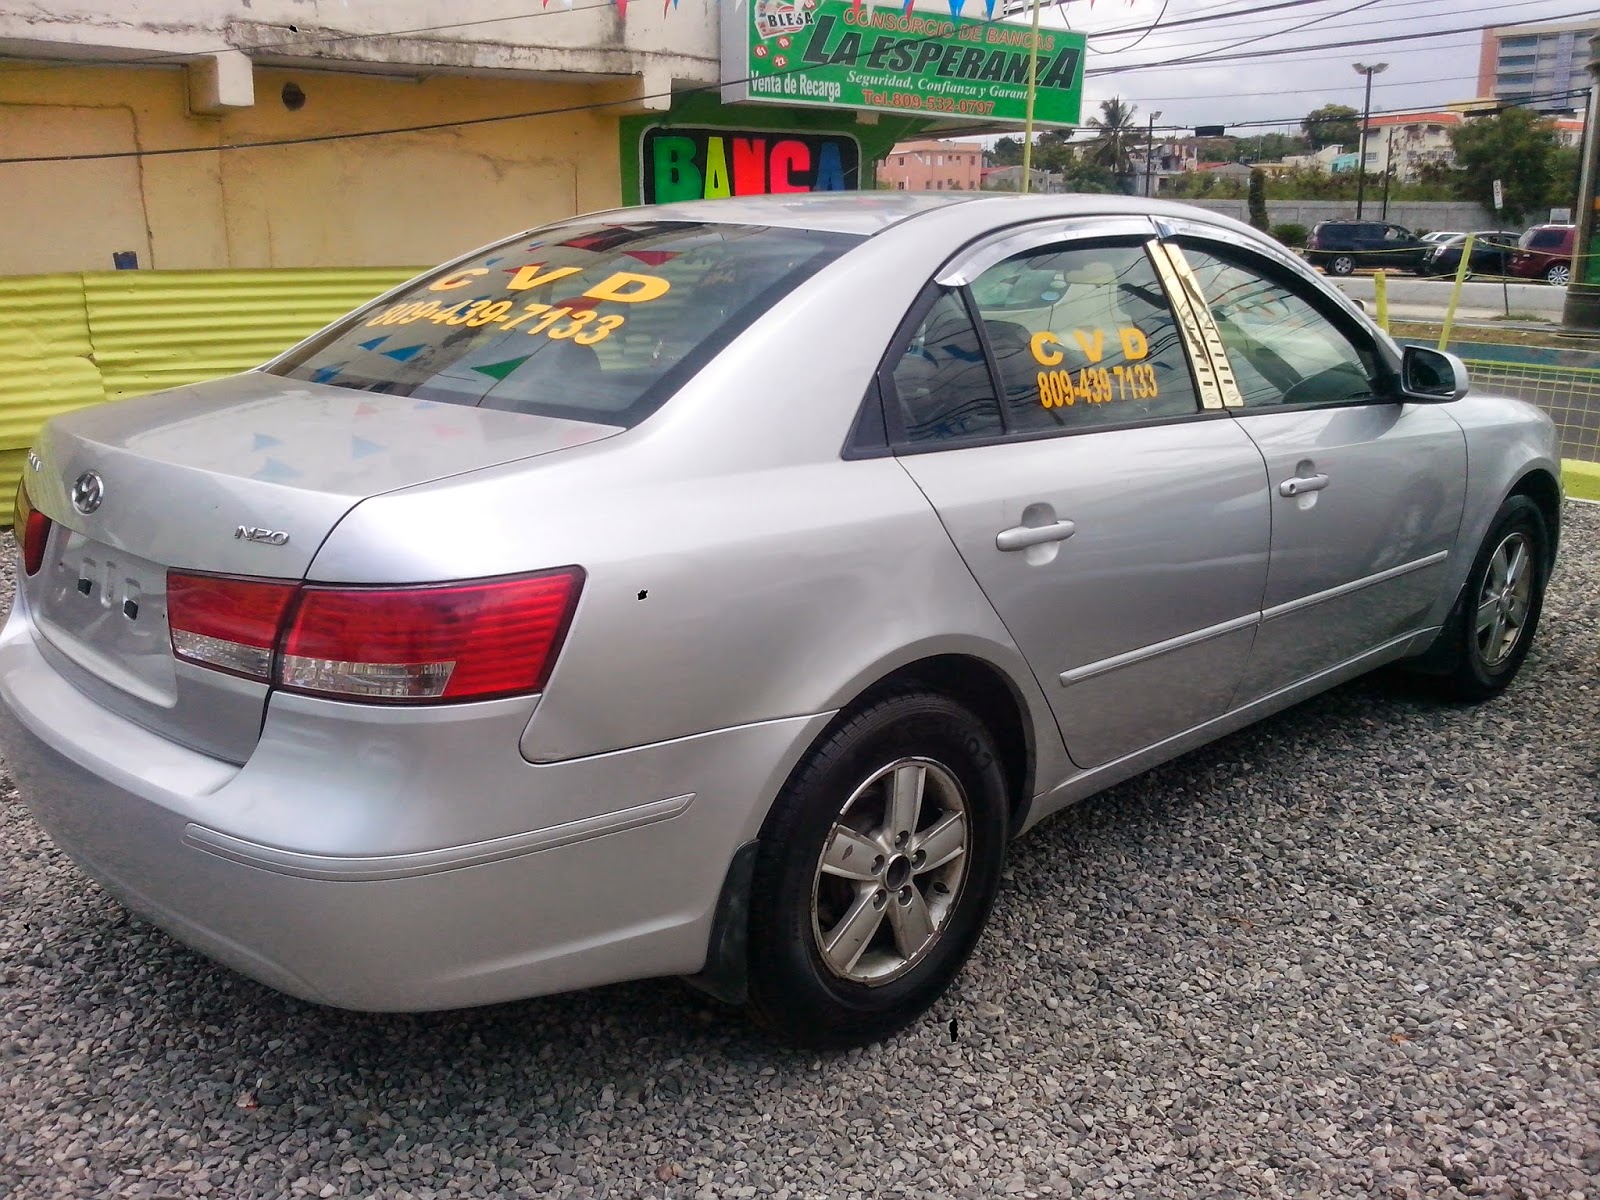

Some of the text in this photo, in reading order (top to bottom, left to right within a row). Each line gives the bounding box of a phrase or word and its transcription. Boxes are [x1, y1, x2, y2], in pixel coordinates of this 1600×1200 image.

[767, 11, 814, 28] BLESA
[843, 8, 1055, 51] CONSORCIO DE BANCAS
[801, 14, 1081, 90] LA ESPERANZA
[751, 70, 841, 102] Venta de Recarga
[846, 71, 1037, 100] Seguridad, Confianza y Garant
[653, 136, 846, 205] BANCA
[365, 299, 624, 345] 809-439-7133
